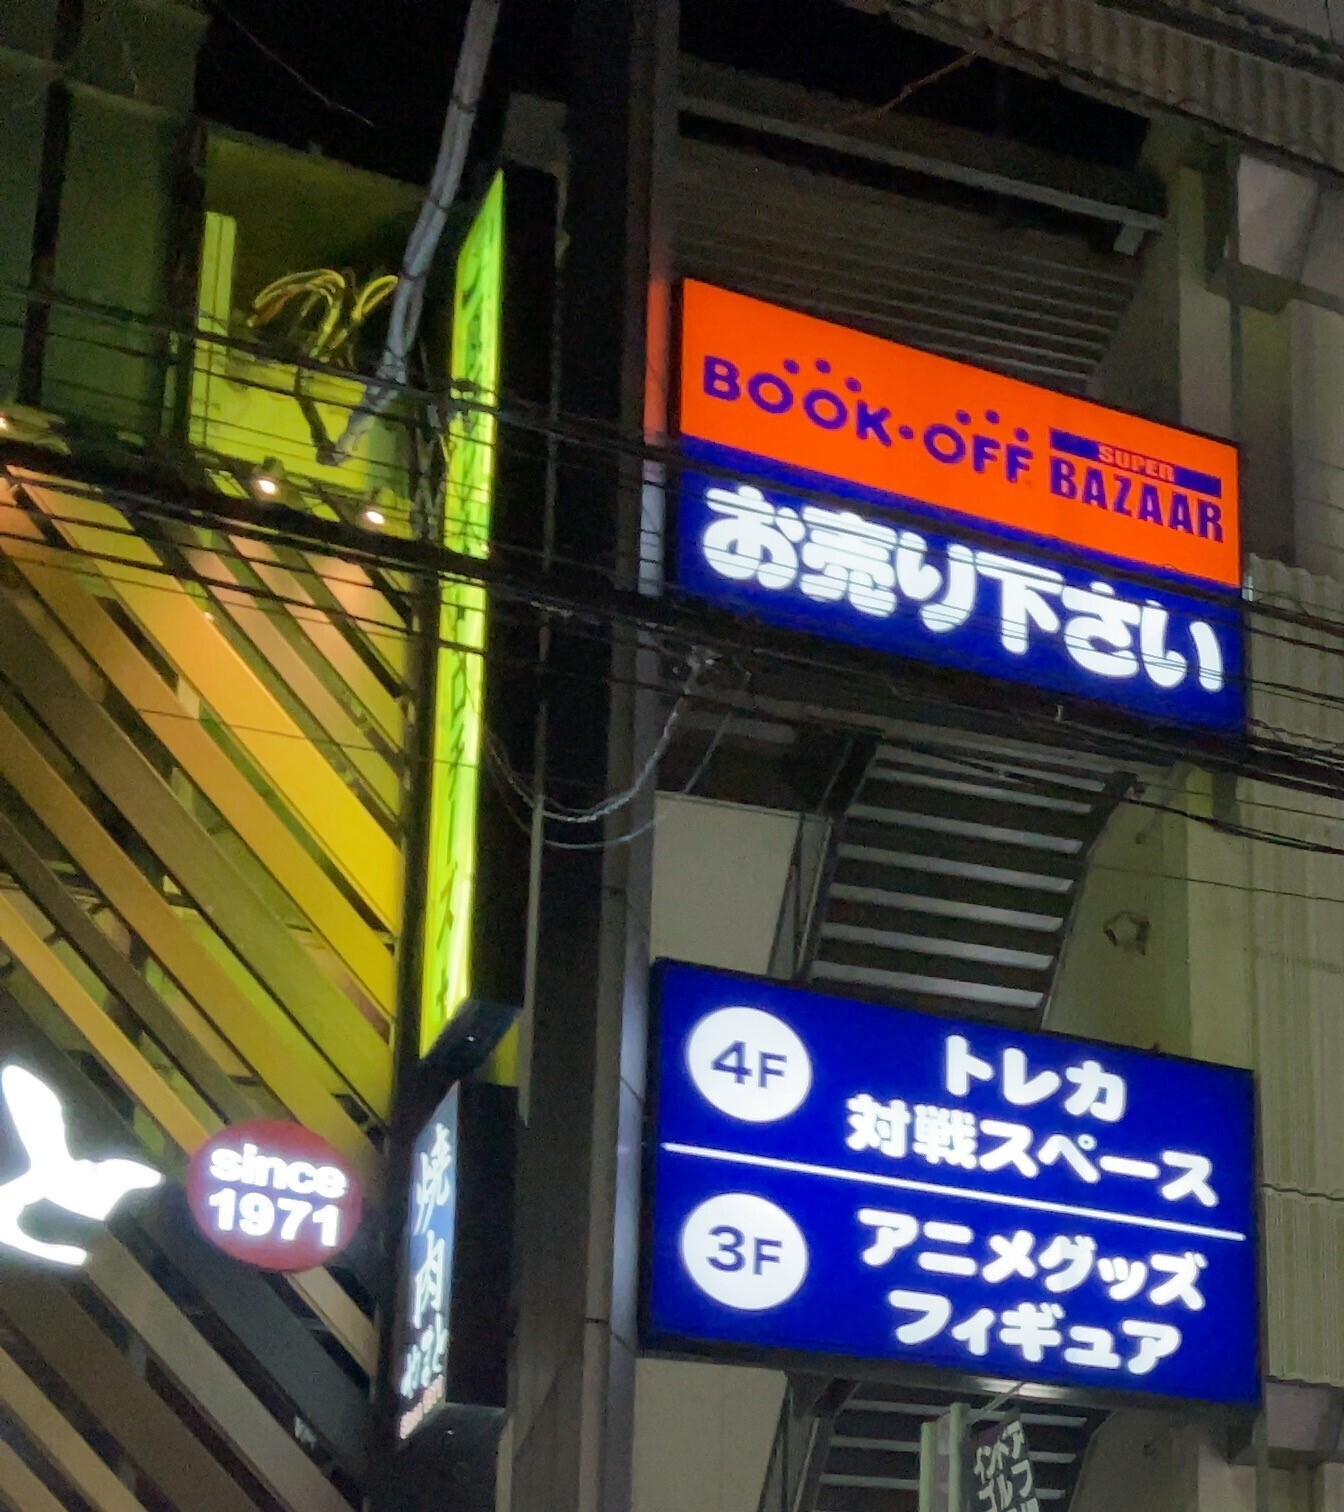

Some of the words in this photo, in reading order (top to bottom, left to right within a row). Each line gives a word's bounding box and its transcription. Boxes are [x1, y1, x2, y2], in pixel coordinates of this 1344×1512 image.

[1048, 454, 1225, 545] BAZAAR
[1096, 443, 1176, 482] SUPER
[702, 484, 1225, 693] お売り下さい
[711, 1039, 788, 1090] 4F
[943, 1034, 1128, 1123] トレカ
[209, 1143, 349, 1199] since
[845, 1093, 1220, 1207] 対戦スペース
[208, 1190, 340, 1248] 1971
[706, 1224, 783, 1277] 3F
[856, 1207, 1208, 1311] アニメグッズ
[887, 1288, 1182, 1376] フィギュア
